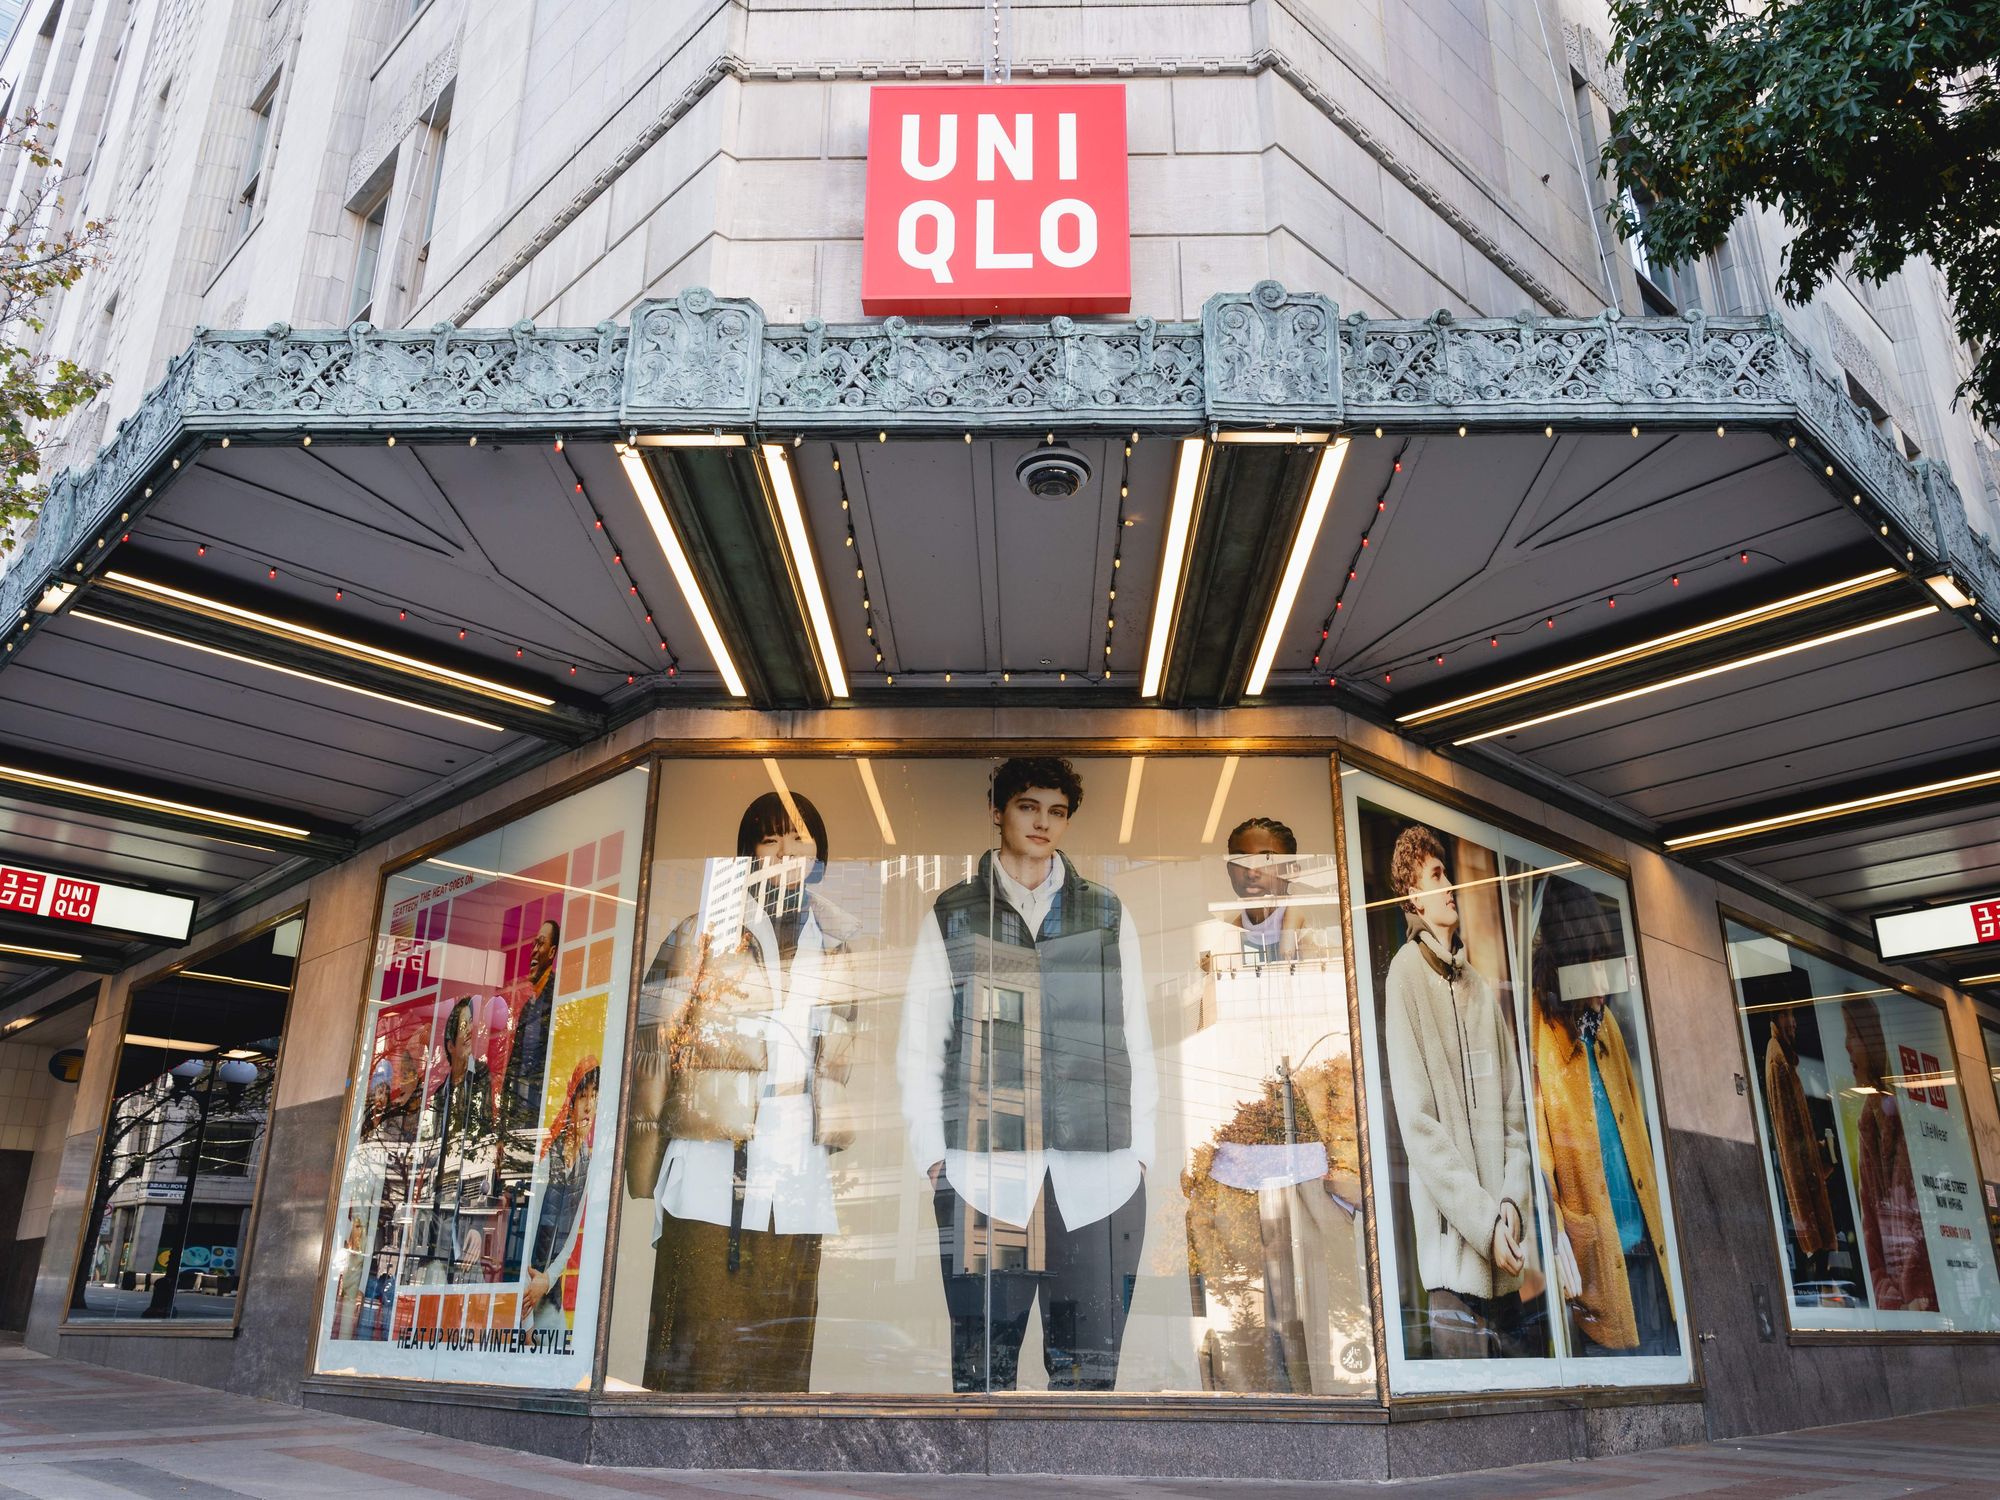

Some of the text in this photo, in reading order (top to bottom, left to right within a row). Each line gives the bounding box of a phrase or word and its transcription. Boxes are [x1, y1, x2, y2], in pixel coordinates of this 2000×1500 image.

[901, 113, 1077, 181] UNI
[898, 198, 1098, 283] QLO
[4, 873, 39, 892] ユニ
[58, 883, 91, 902] UNI
[420, 889, 431, 903] THE
[432, 883, 449, 899] HEAT
[449, 879, 464, 892] GOES
[55, 899, 91, 918] QLO
[397, 1327, 575, 1356] HEAT UP YOUR WINTER STYLE.
